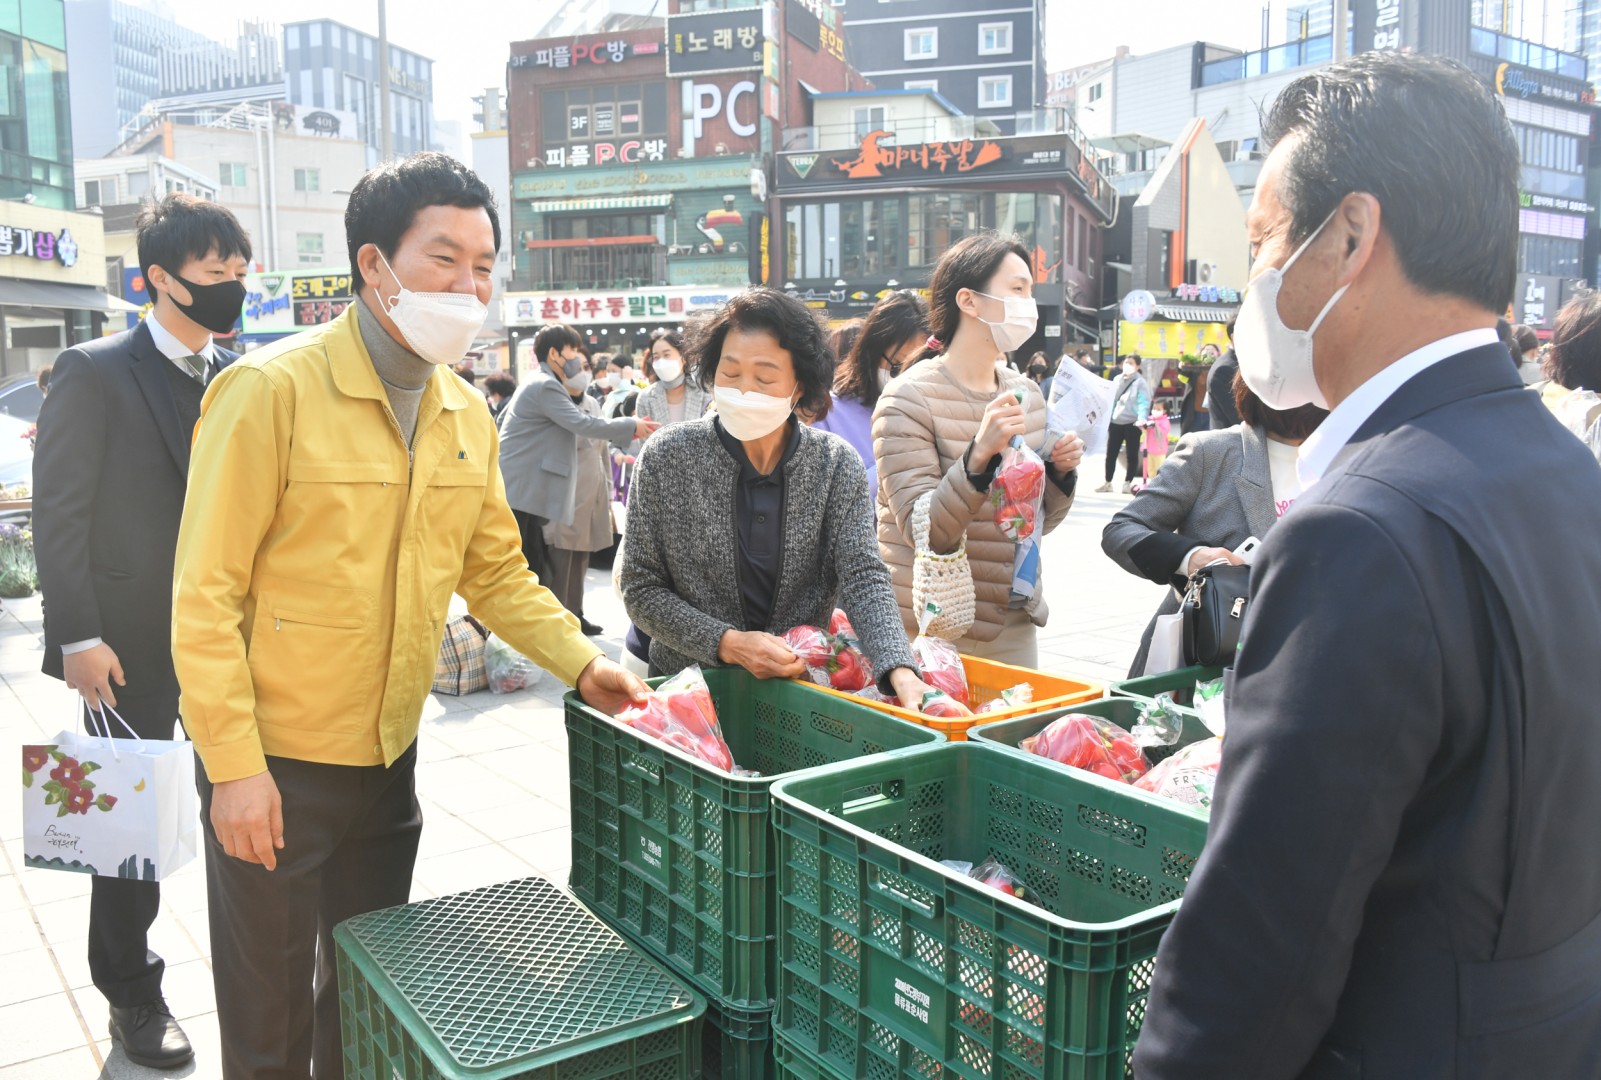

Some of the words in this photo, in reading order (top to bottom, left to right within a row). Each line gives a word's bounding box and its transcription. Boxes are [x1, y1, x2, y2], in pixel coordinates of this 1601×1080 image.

[688, 26, 758, 52] 노래방
[512, 56, 527, 67] 3F
[536, 40, 627, 68] 피플PC방
[1503, 70, 1539, 98] Allegra
[315, 115, 333, 128] 401
[571, 116, 587, 129] 3F
[693, 81, 756, 138] PC
[546, 139, 667, 168] 피플PC방
[292, 276, 352, 297] 조개구이
